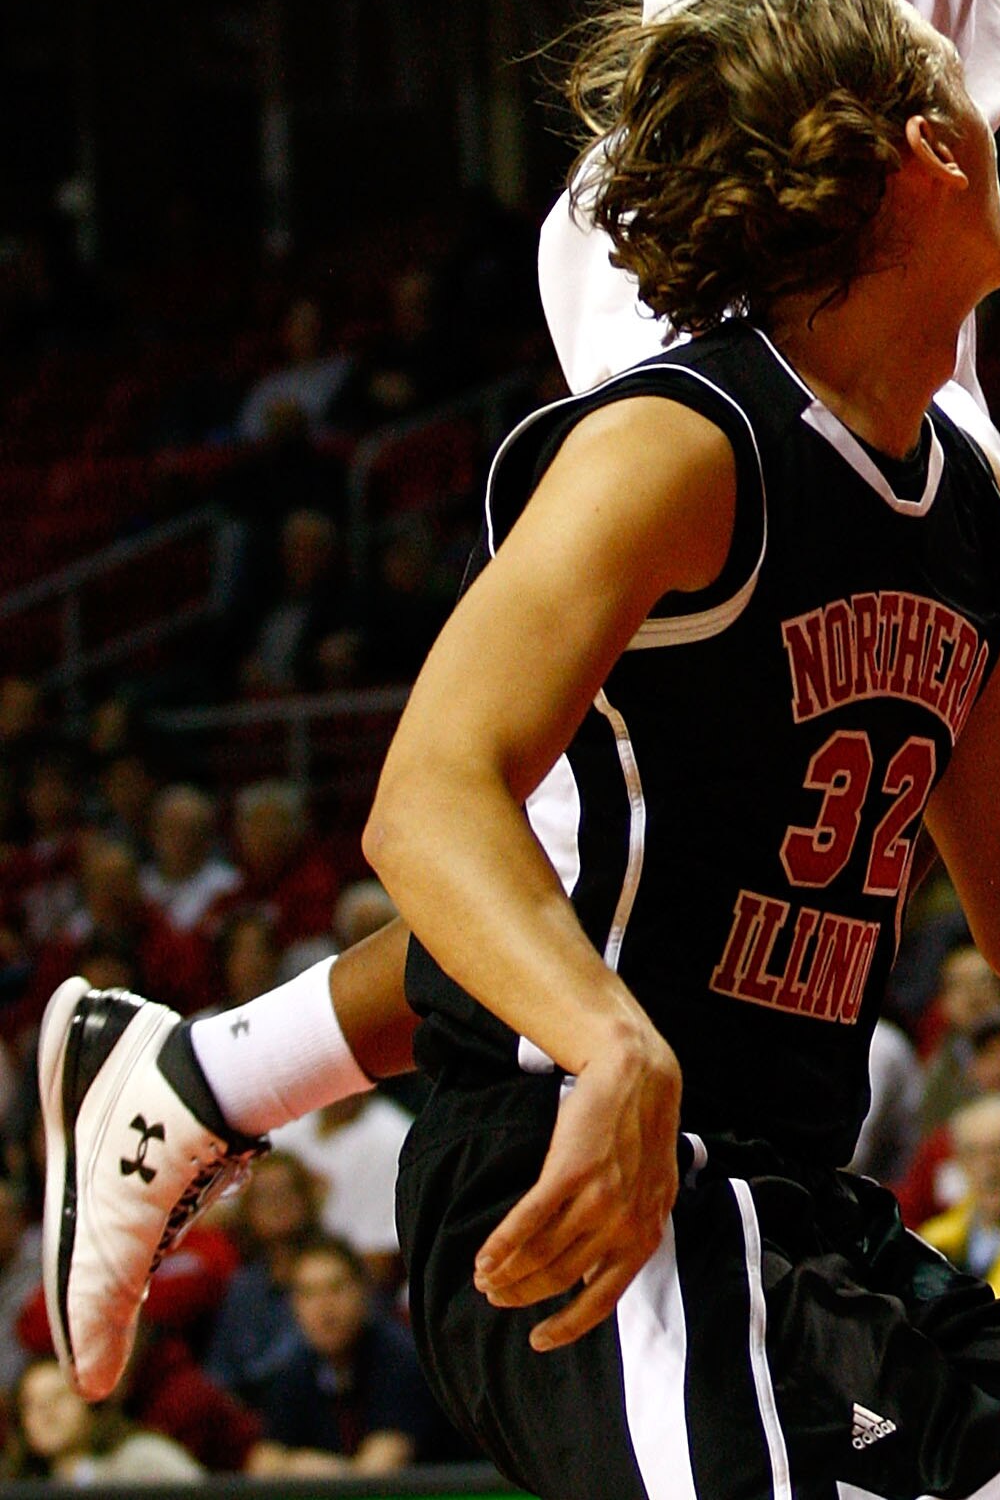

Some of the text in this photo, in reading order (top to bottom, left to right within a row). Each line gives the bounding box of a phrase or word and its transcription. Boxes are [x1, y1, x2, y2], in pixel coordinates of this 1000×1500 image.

[777, 730, 937, 897] 32
[708, 888, 882, 1026] ILLINO
[851, 1418, 897, 1450] adidas
